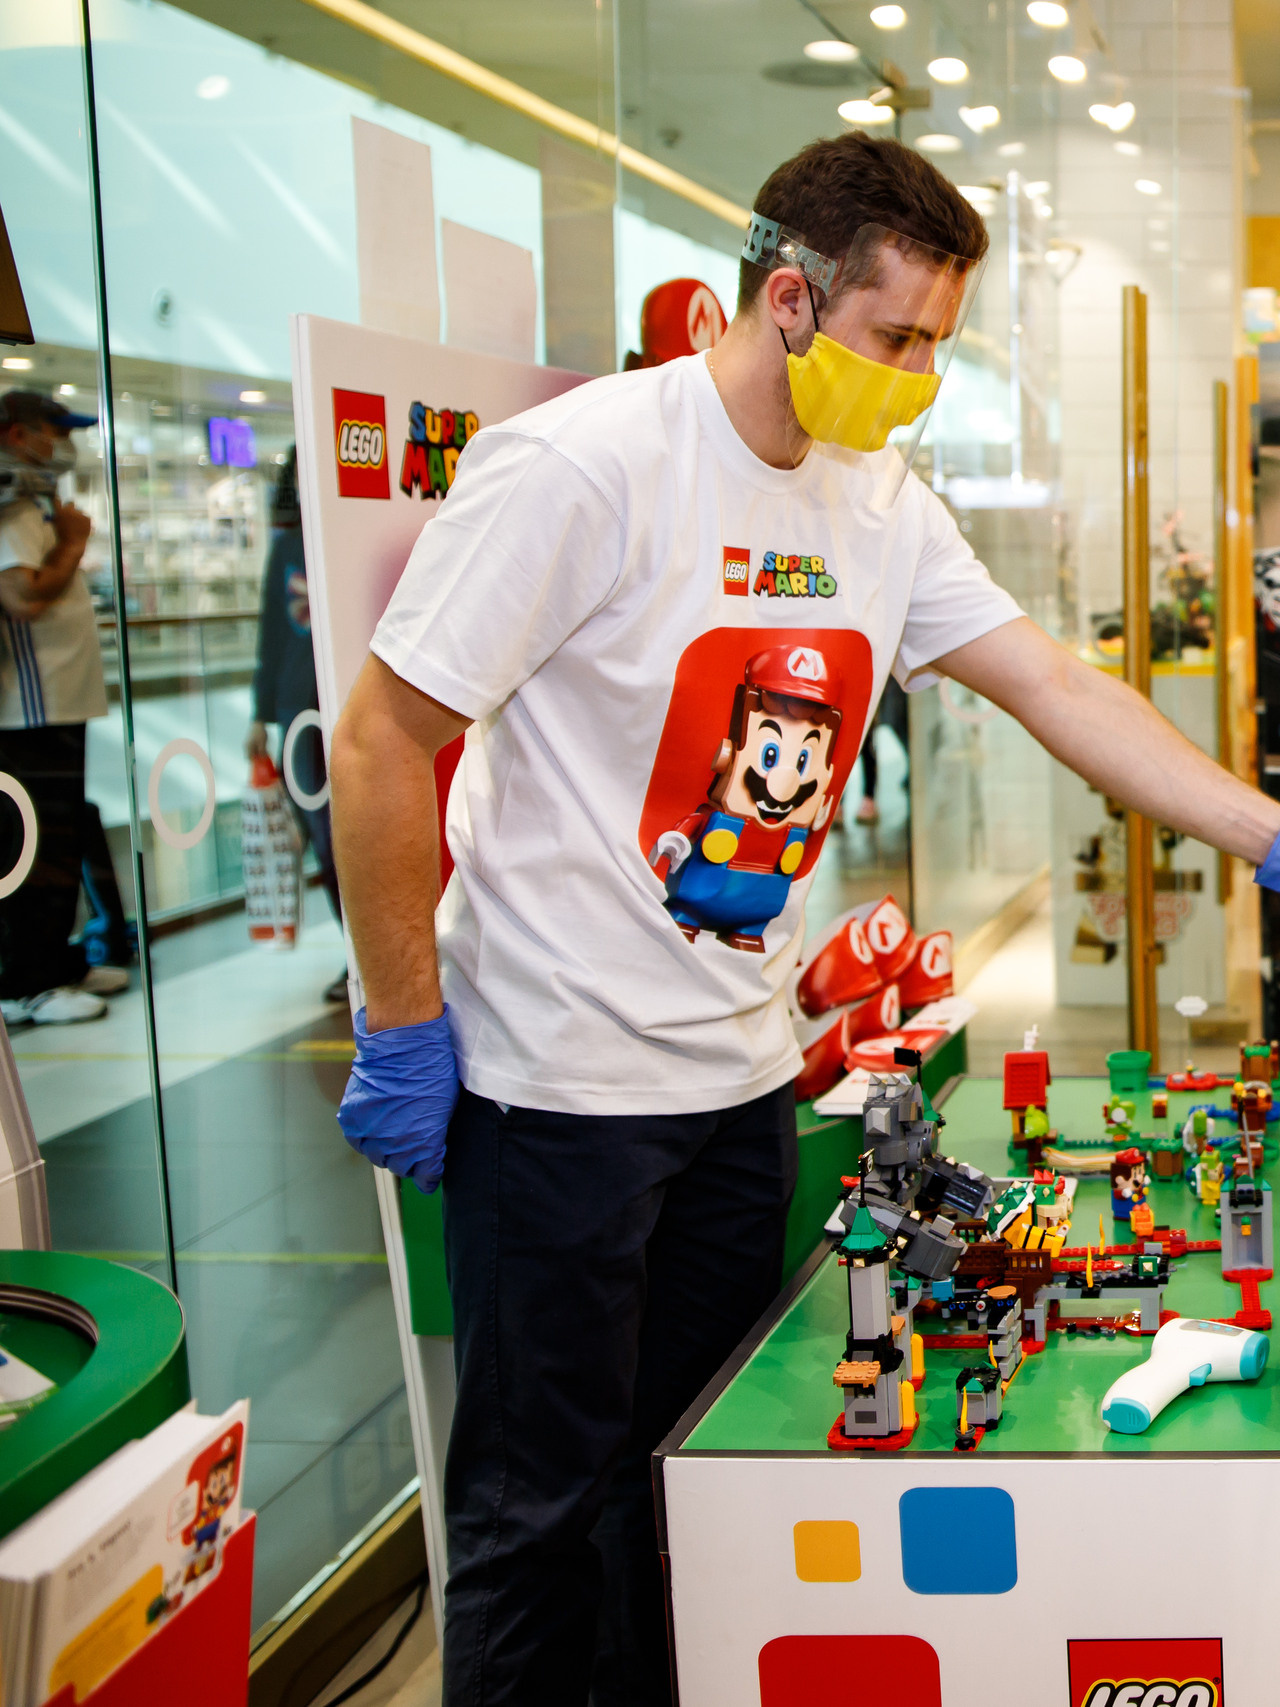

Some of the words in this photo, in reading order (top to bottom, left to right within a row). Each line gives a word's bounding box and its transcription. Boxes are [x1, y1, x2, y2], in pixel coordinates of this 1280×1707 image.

[338, 421, 385, 467] LEGO
[725, 560, 748, 582] LEGO
[763, 551, 826, 575] SUPER
[753, 569, 837, 599] MARIO
